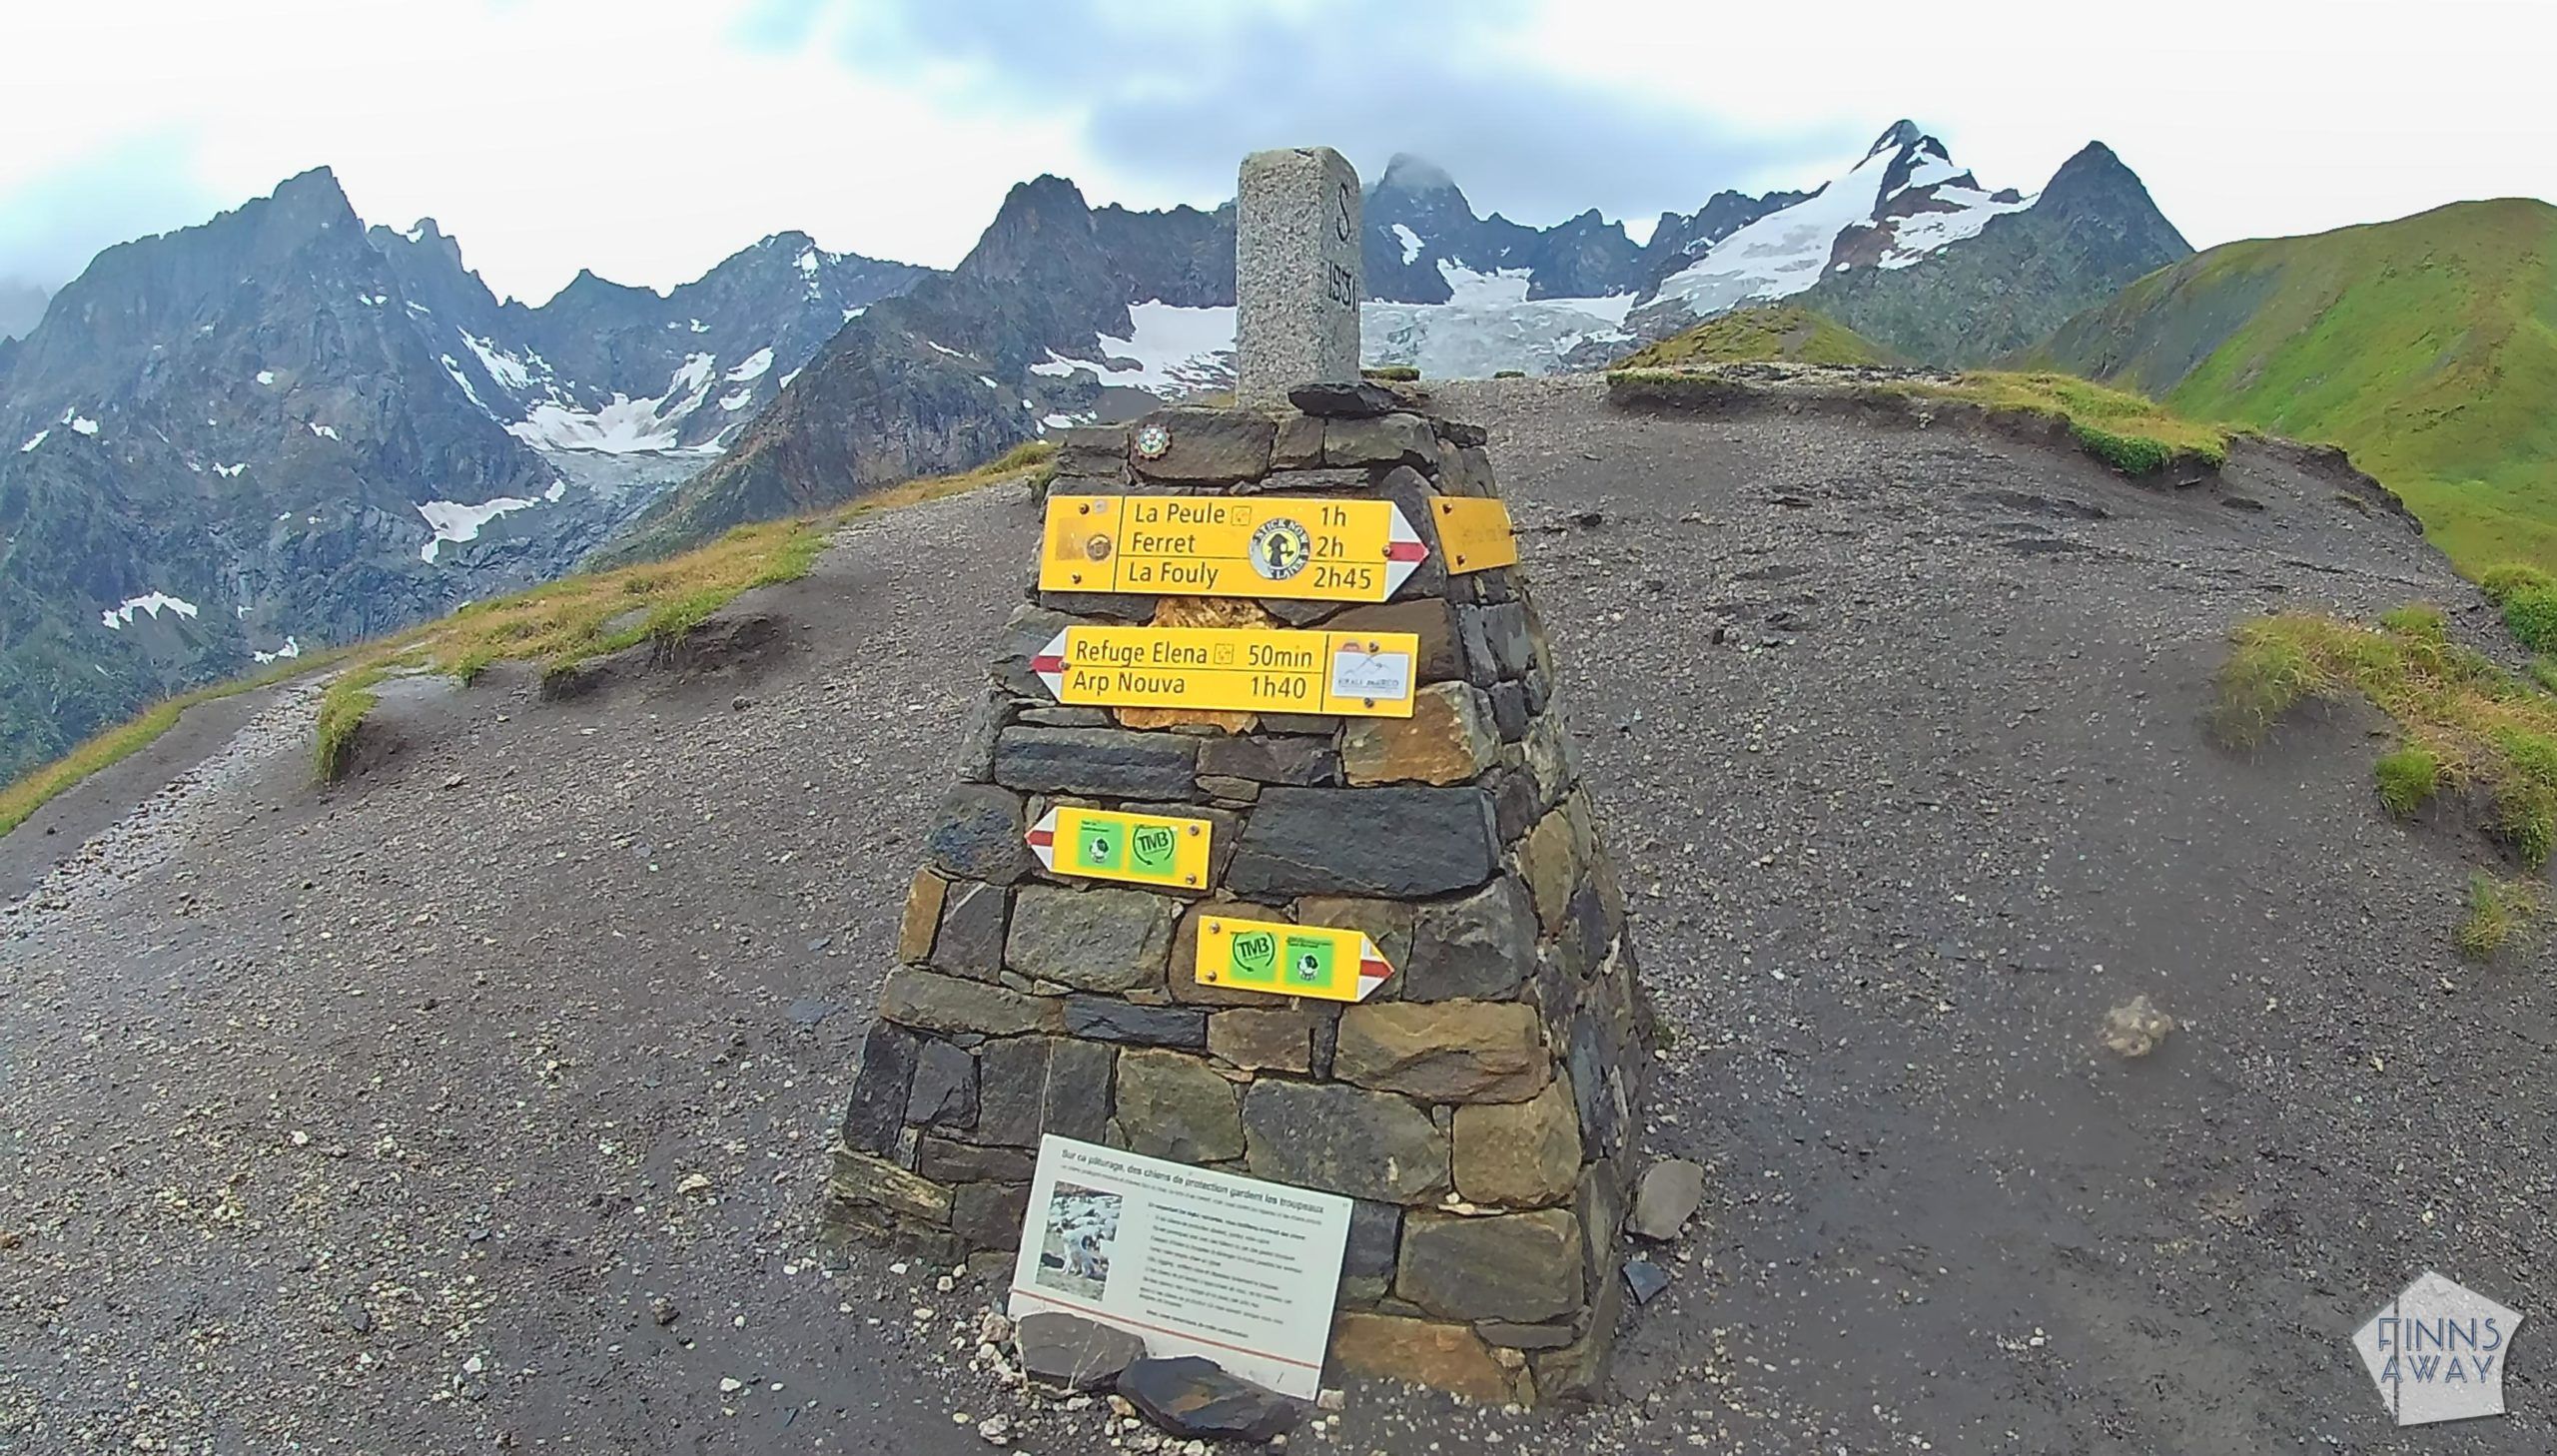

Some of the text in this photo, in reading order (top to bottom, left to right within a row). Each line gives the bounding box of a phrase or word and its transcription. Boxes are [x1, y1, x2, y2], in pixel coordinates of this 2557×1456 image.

[1328, 261, 1356, 313] 1931
[1136, 502, 1346, 526] La Peule 1h
[1254, 518, 1286, 540] STICK
[1132, 531, 1343, 557] Ferret 2h
[1129, 561, 1371, 589] La Fouly 2h45
[1076, 639, 1312, 668] Refuge Elena 50min
[1073, 670, 1306, 699] Arp Nouva 1h40
[1137, 831, 1169, 852] TMB
[1236, 937, 1270, 958] TMB
[1061, 1148, 1077, 1159] Sur
[1127, 1164, 1143, 1175] des
[1144, 1167, 1171, 1181] chiens
[1185, 1178, 1229, 1194] protection
[1230, 1188, 1263, 1201] gardent
[1265, 1193, 1278, 1204] les
[1279, 1197, 1324, 1214] troupeaux
